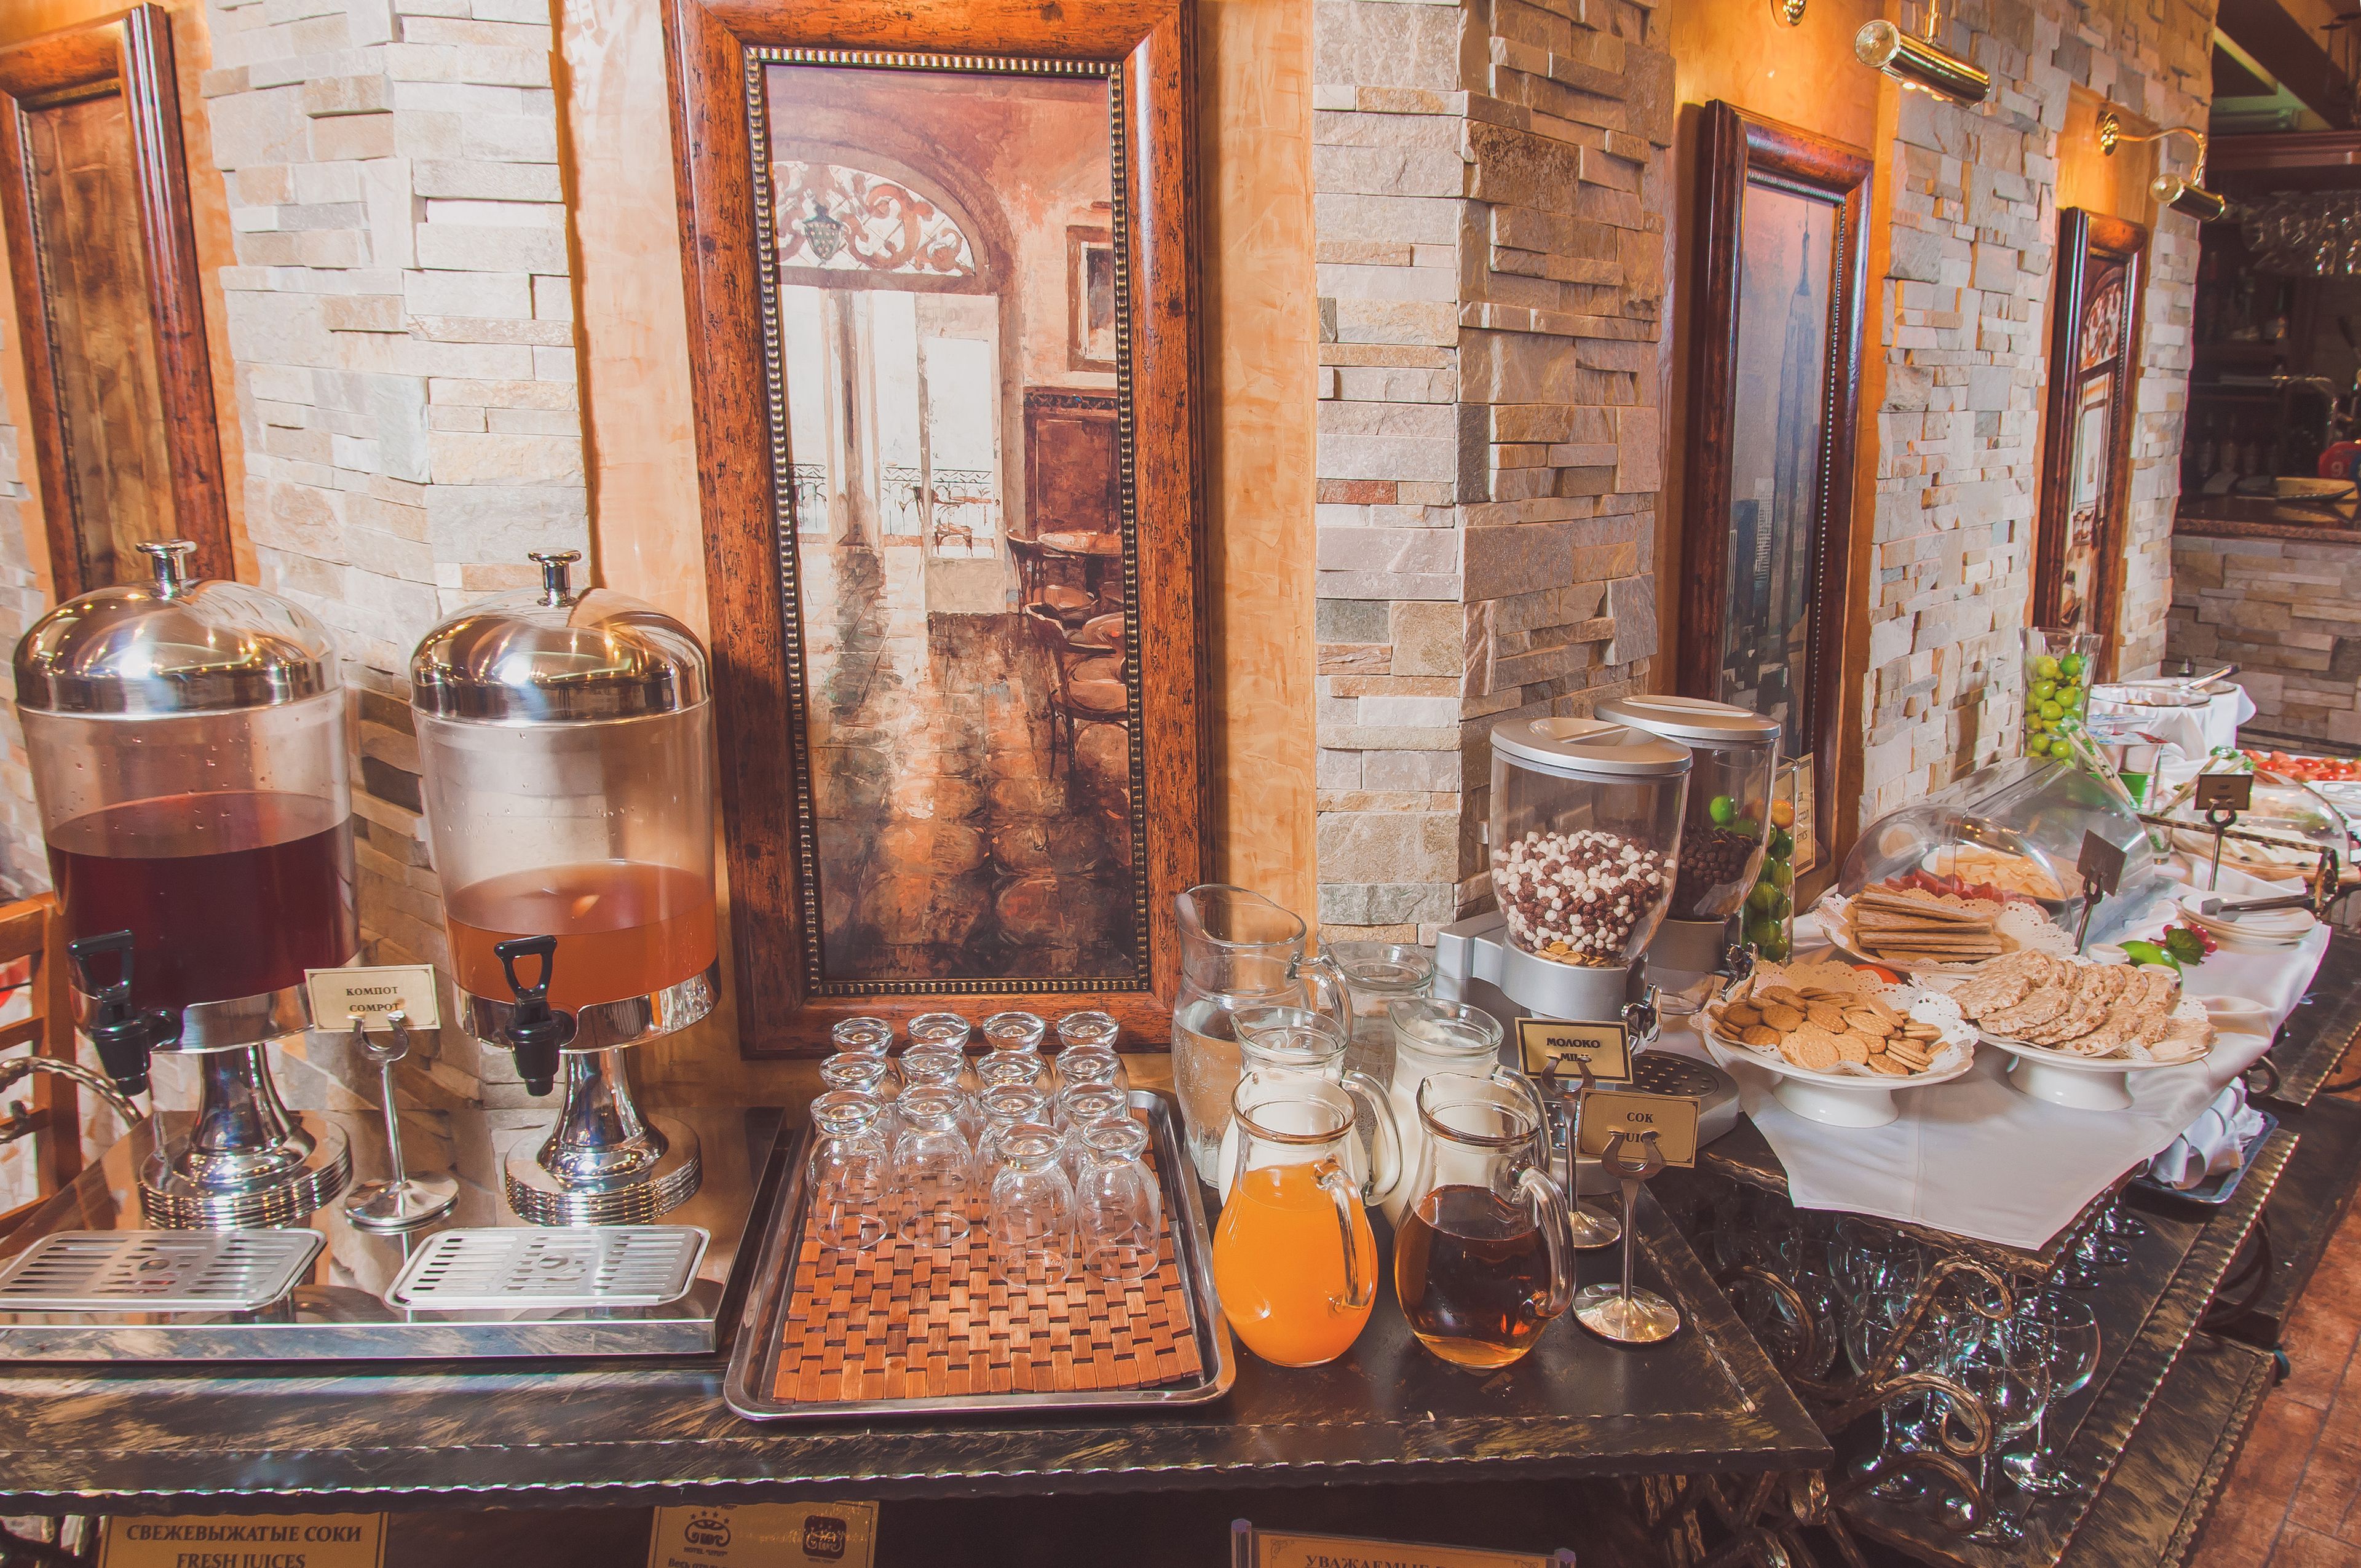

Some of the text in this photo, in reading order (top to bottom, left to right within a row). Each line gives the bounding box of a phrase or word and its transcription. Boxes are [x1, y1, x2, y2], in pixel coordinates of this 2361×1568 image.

[346, 986, 398, 997] КОМПОТ
[349, 1002, 401, 1012] COMPOT
[1546, 1037, 1601, 1049] МОЛОКО
[1560, 1053, 1590, 1062] MIL
[1626, 1111, 1654, 1123] СОК
[126, 1524, 363, 1542] СВЕЖЕВЫЖАТЫЕ СОКИ
[176, 1553, 306, 1568] FRESH JUICES
